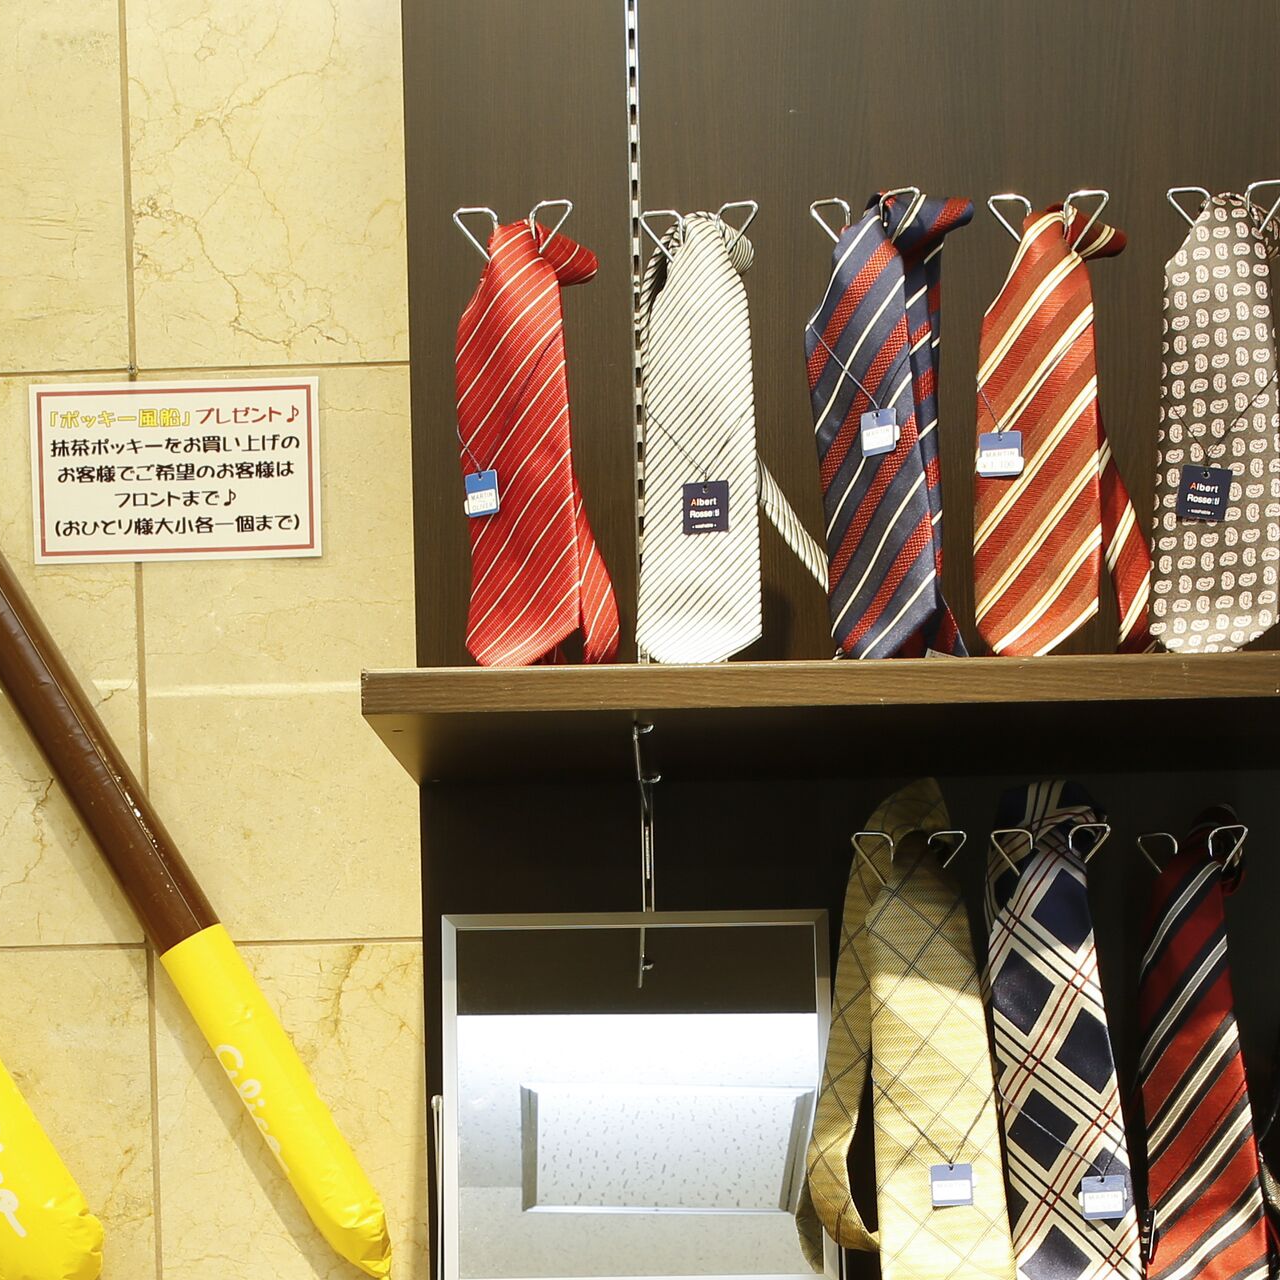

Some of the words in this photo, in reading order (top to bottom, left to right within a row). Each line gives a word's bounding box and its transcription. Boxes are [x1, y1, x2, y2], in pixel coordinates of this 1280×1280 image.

[50, 435, 300, 457] 抹茶ポッキーをお買い上げの
[57, 461, 295, 483] お客様でご希望のお客様は
[54, 514, 300, 537] (おひとり様大小各一個まで)
